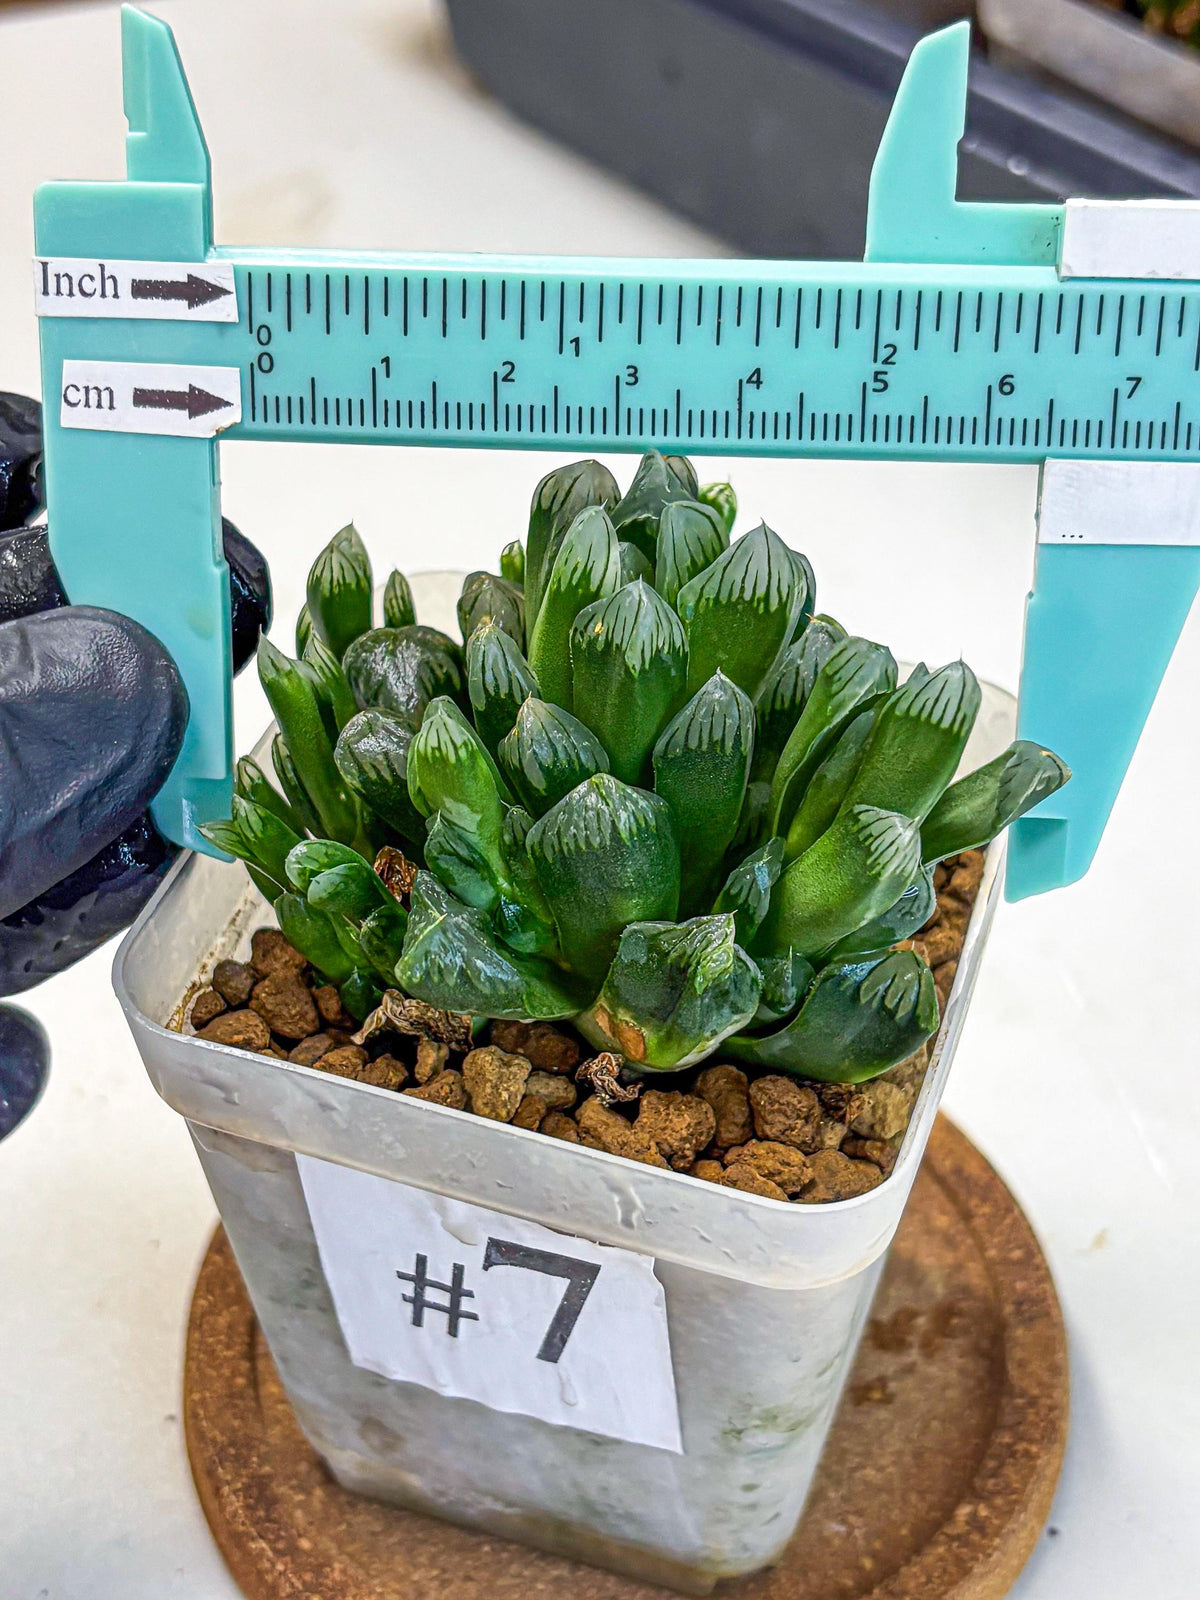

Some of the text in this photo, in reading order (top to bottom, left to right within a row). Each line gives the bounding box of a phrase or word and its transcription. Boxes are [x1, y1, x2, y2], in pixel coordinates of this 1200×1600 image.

[39, 261, 120, 299] Inch
[256, 324, 897, 366] 0 1 2
[257, 352, 1143, 399] 0 1 2 3 4 5 6 7
[62, 383, 117, 411] cm
[396, 1236, 602, 1364] #7
